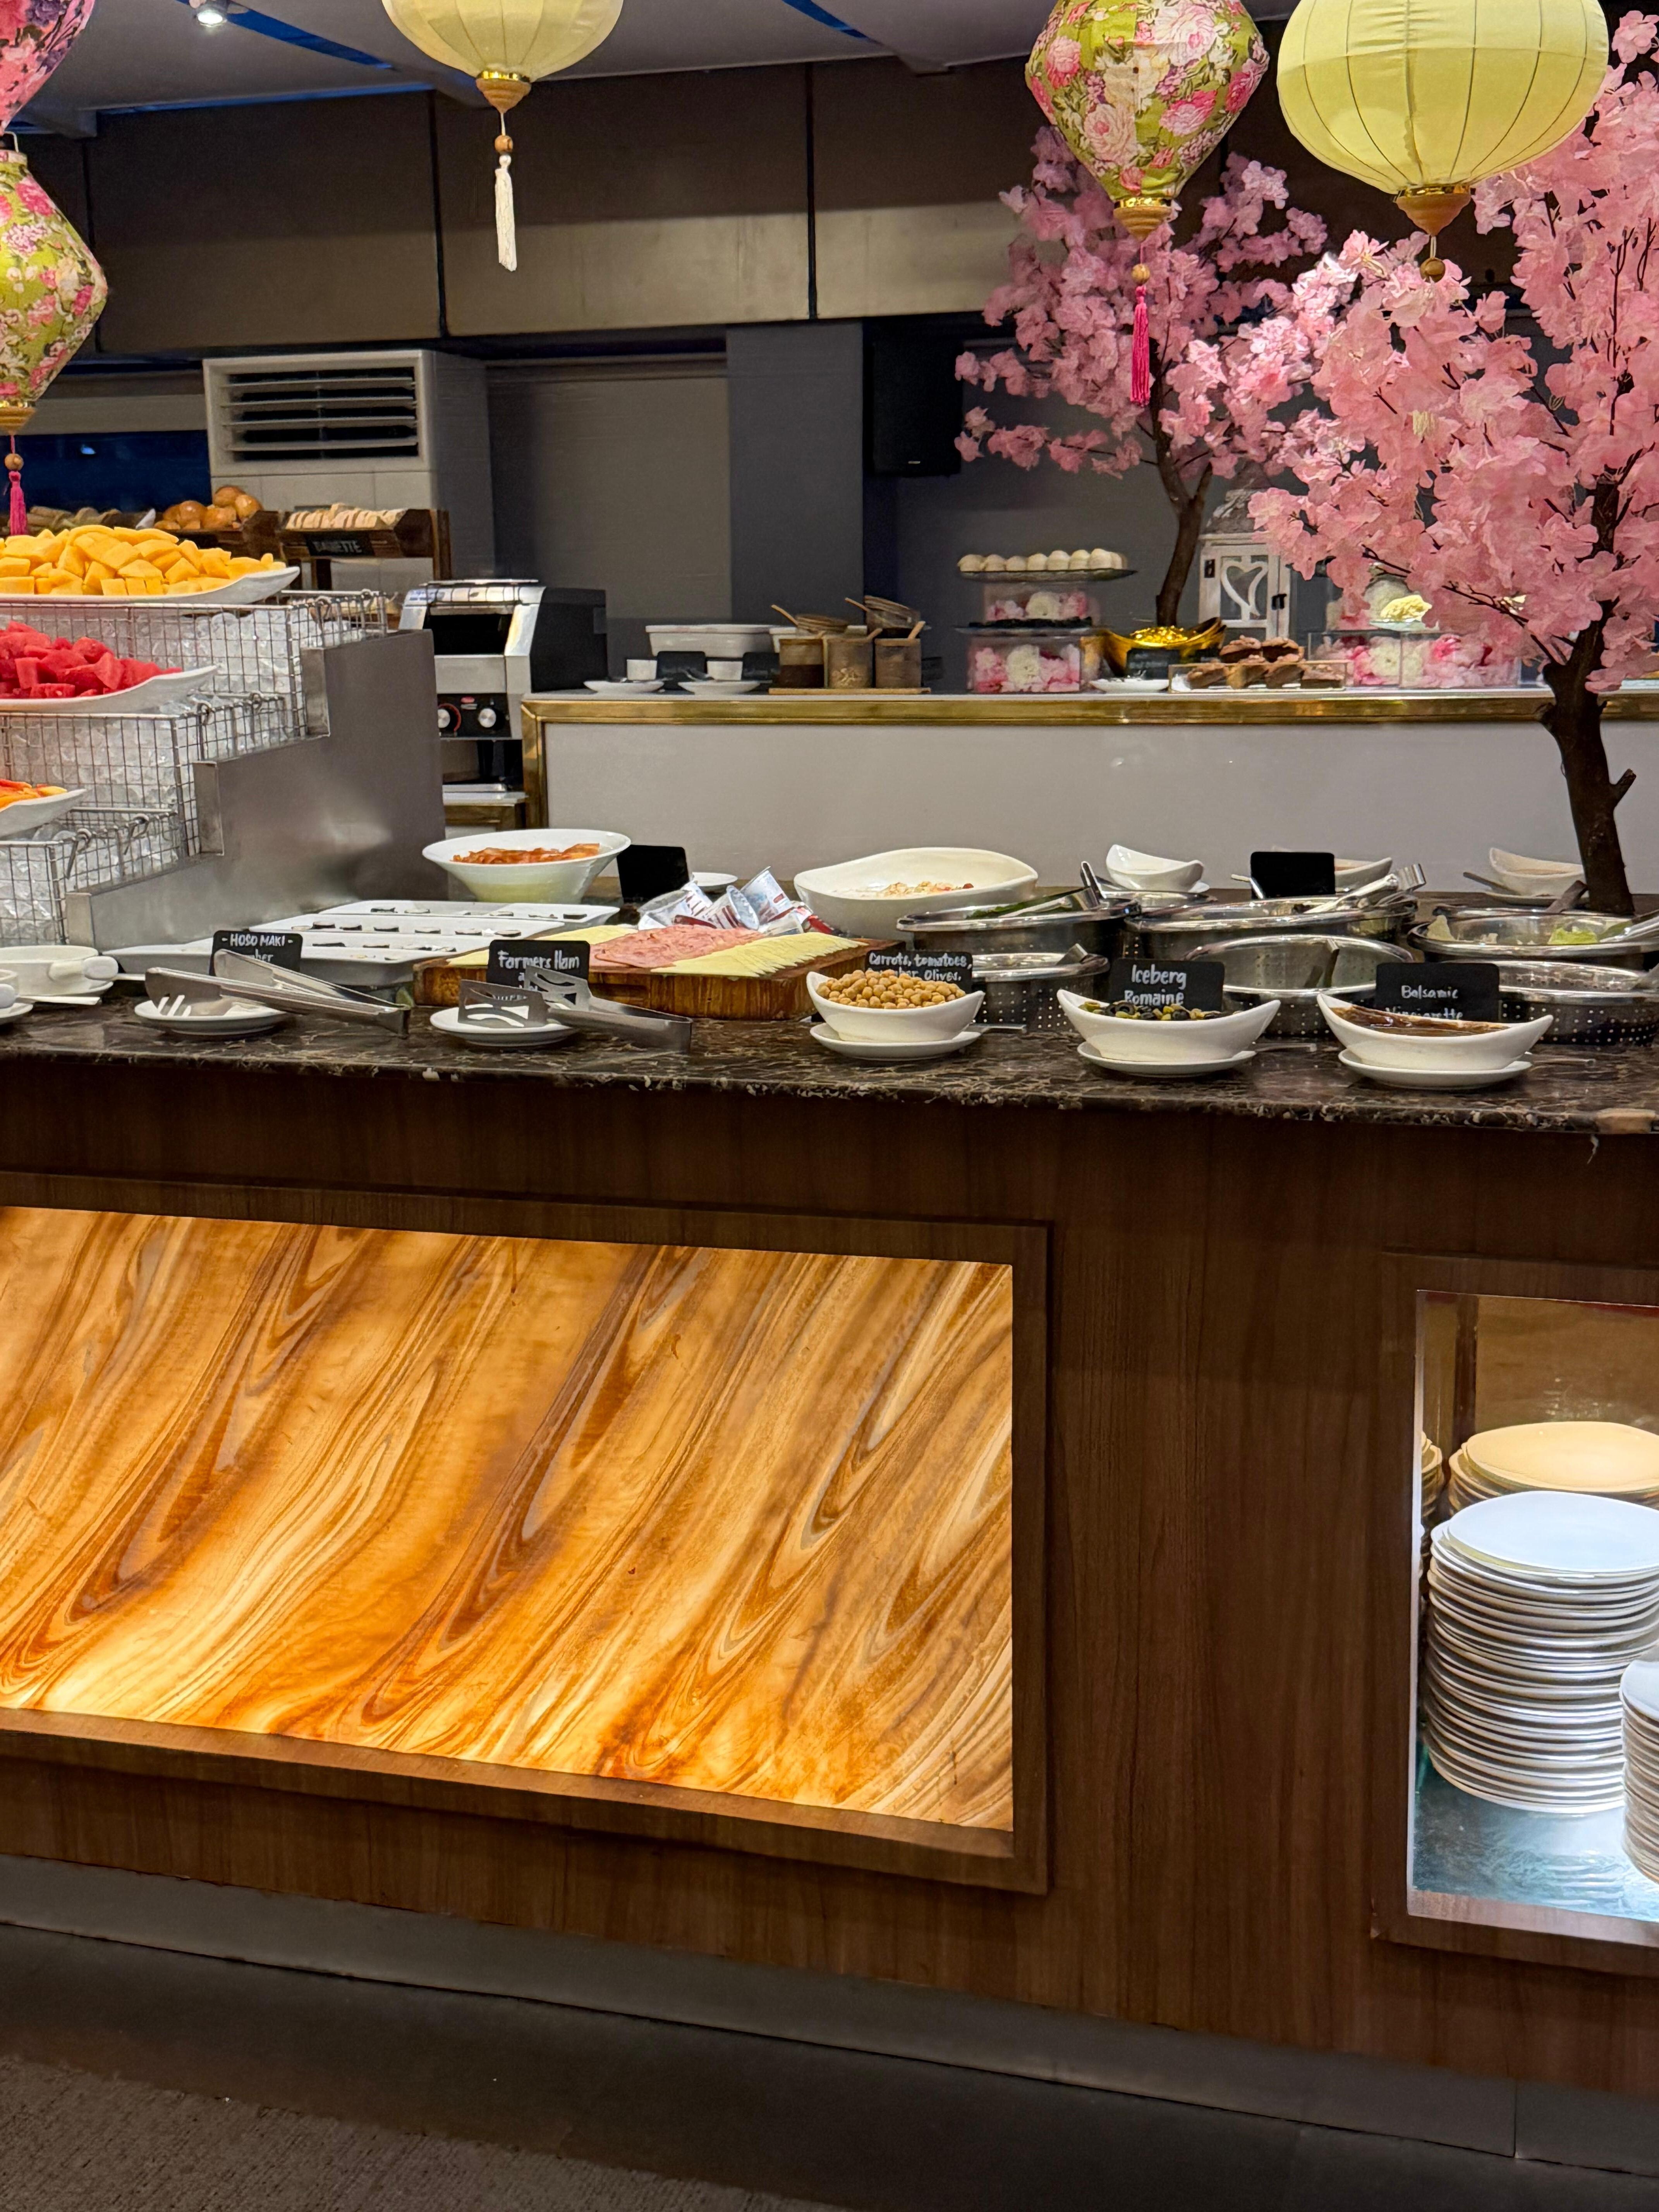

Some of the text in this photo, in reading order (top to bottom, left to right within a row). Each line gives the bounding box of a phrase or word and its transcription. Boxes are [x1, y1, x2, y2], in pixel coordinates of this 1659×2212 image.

[230, 933, 258, 947] HOSO
[259, 934, 285, 946] MAKI
[869, 952, 912, 967] Carrots,
[1131, 964, 1187, 990] Iceberg
[1124, 989, 1184, 1006] Romaine
[1401, 985, 1458, 999] Balsamic
